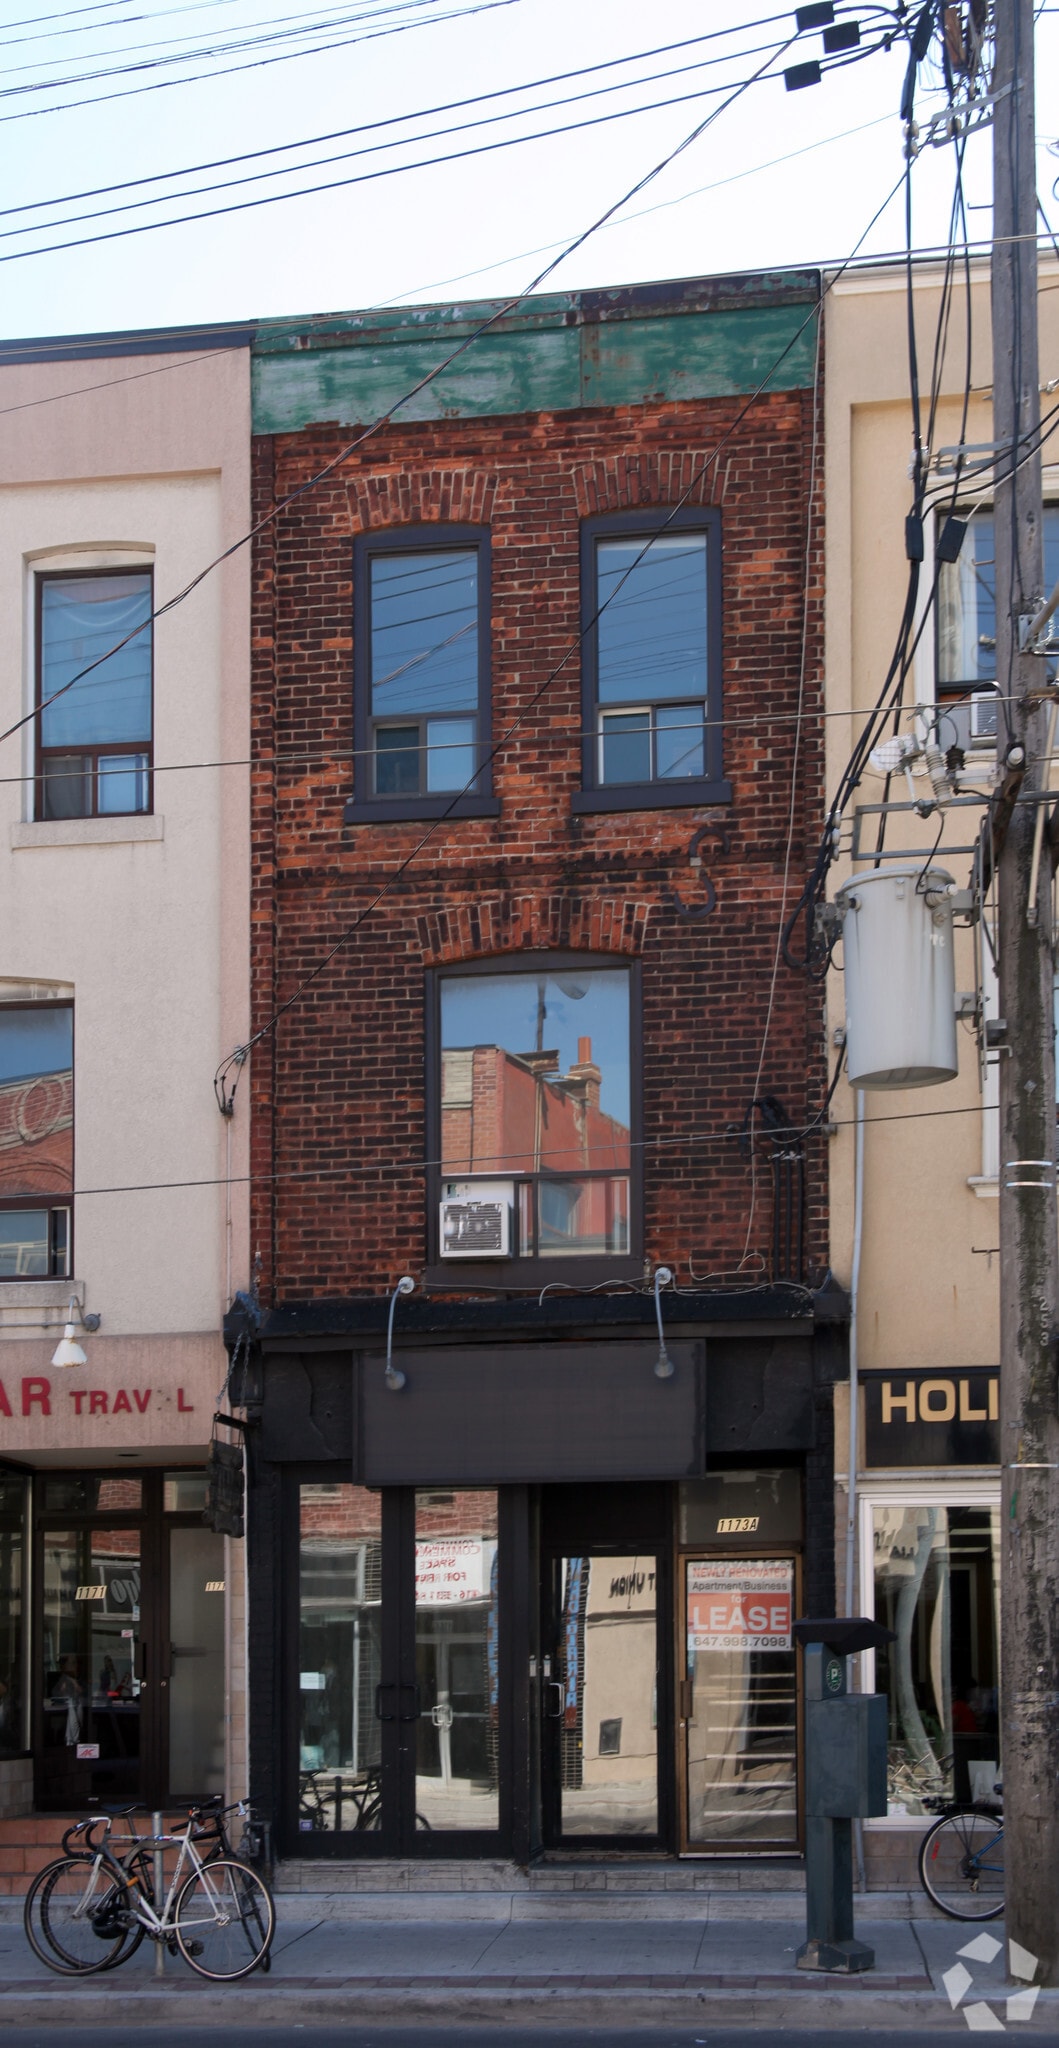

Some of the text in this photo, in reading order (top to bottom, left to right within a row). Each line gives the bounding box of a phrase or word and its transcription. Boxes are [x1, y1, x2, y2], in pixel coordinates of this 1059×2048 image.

[69, 1388, 194, 1415] TRAVL
[881, 1379, 999, 1423] HOLI
[719, 1518, 757, 1531] 1173A
[692, 1567, 788, 1578] NEWLY RENOVATED
[77, 1585, 106, 1600] 1171
[692, 1581, 788, 1592] Apartment/Business
[730, 1595, 748, 1604] for
[693, 1606, 788, 1631] LEASE
